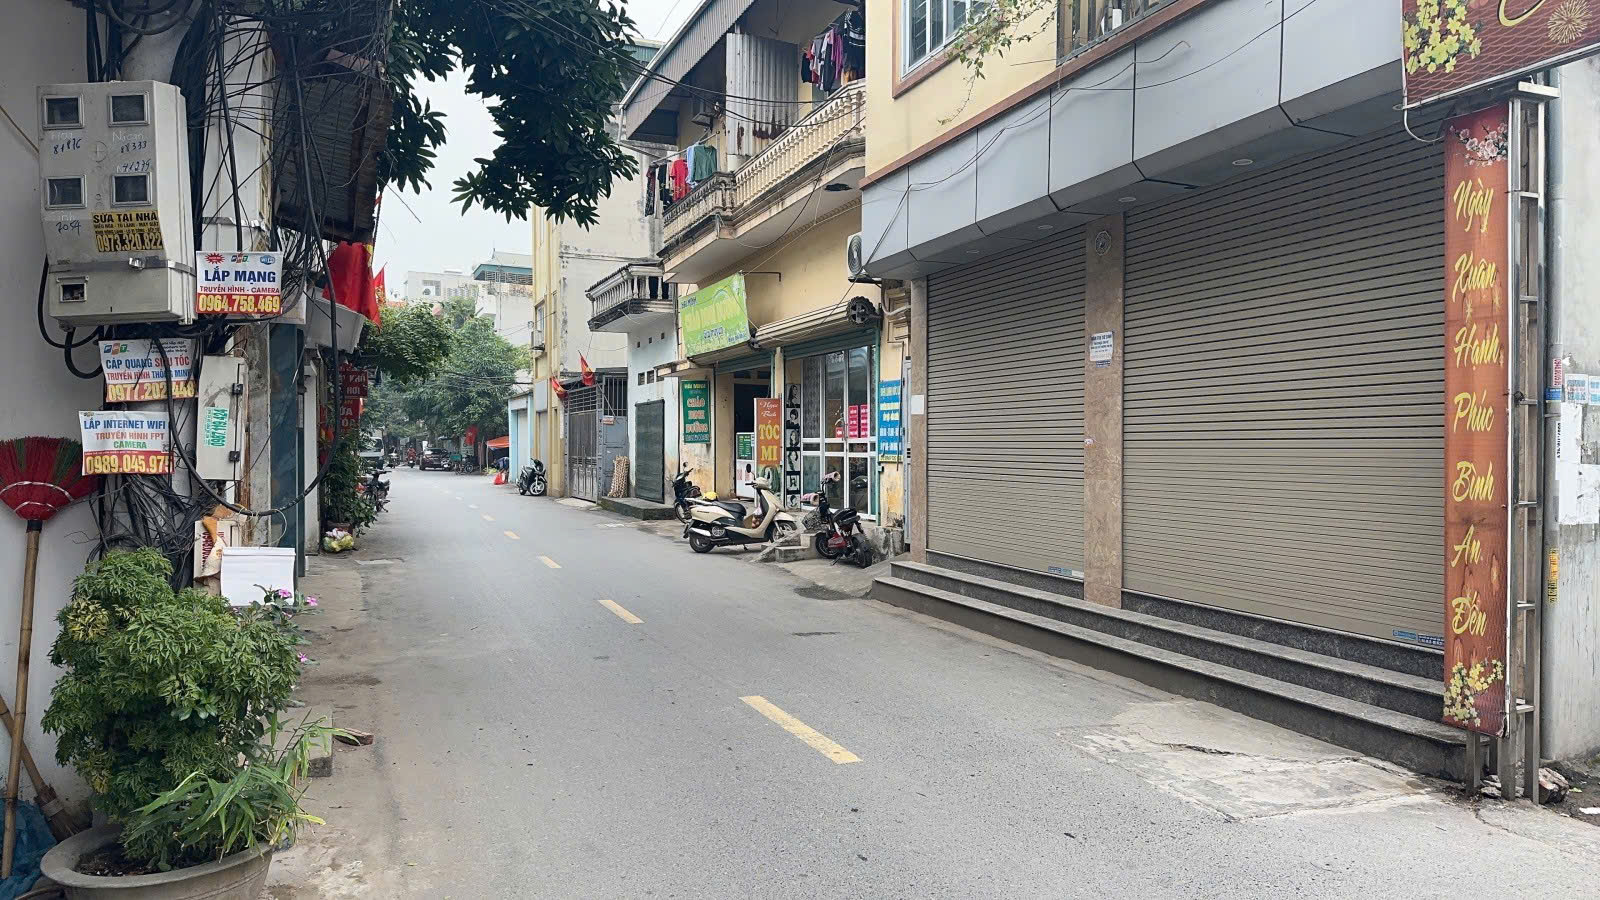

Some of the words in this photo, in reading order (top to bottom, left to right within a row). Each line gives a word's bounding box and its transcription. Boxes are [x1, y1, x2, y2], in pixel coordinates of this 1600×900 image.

[1453, 178, 1494, 233] Ngày
[136, 211, 158, 221] NHÀ
[97, 232, 162, 251] 0973.320.822
[204, 266, 230, 282] LẮP
[234, 270, 276, 285] MẠNG
[1452, 251, 1497, 302] Xuân
[227, 285, 245, 293] HÌNH
[200, 294, 280, 313] 0964.758.469
[1454, 322, 1501, 370] Hạnh
[125, 358, 153, 369] QUANG
[154, 357, 173, 367] SIU
[174, 353, 190, 366] TỐC
[1453, 390, 1495, 432] Phúc
[104, 420, 144, 429] INTERNET
[147, 420, 166, 429] WIFI
[758, 420, 780, 440] TÓC
[114, 441, 147, 449] CAMERA
[150, 432, 165, 440] FPT
[760, 445, 777, 461] MI
[1452, 460, 1495, 502] Bình
[1451, 524, 1481, 568] An
[1452, 591, 1487, 637] Đến
